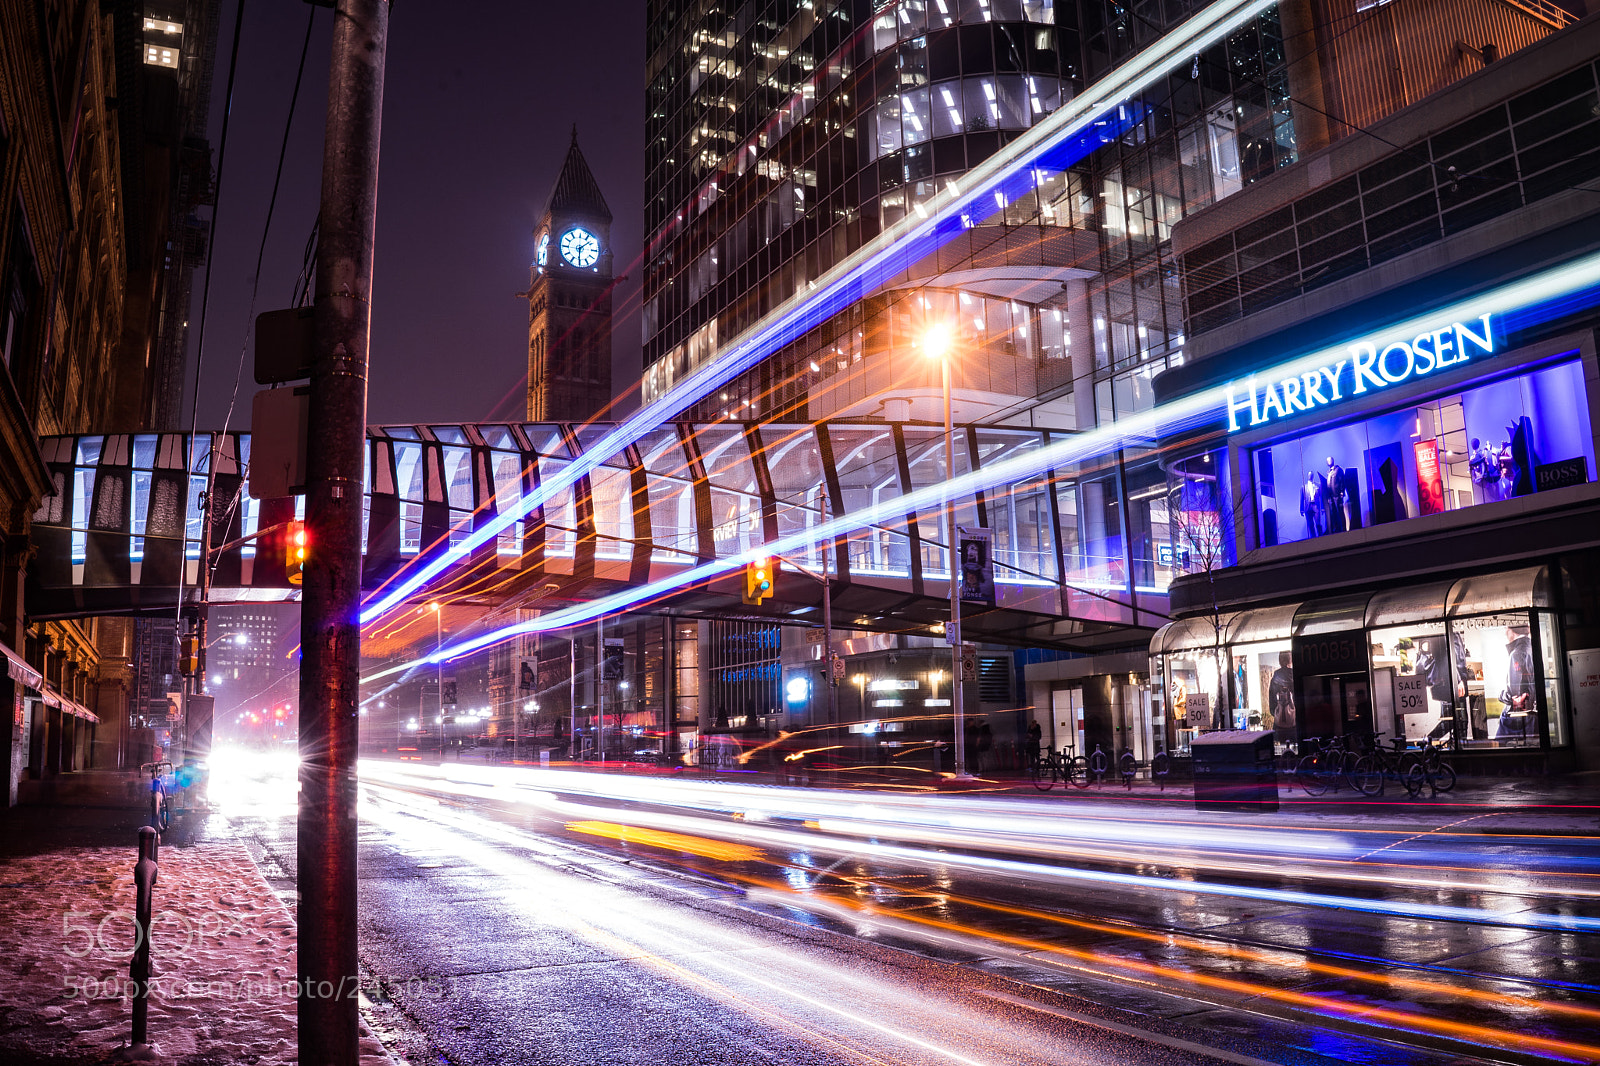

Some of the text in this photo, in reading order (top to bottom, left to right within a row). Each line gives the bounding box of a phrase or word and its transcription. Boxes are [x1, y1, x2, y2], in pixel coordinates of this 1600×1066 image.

[1224, 312, 1495, 432] HARRY ROSEN
[1540, 465, 1578, 484] BOSS
[1301, 640, 1356, 664] m0851
[1398, 680, 1422, 691] SALE
[1188, 698, 1206, 707] SALE
[1401, 694, 1423, 708] 50%
[1190, 709, 1207, 721] 50%
